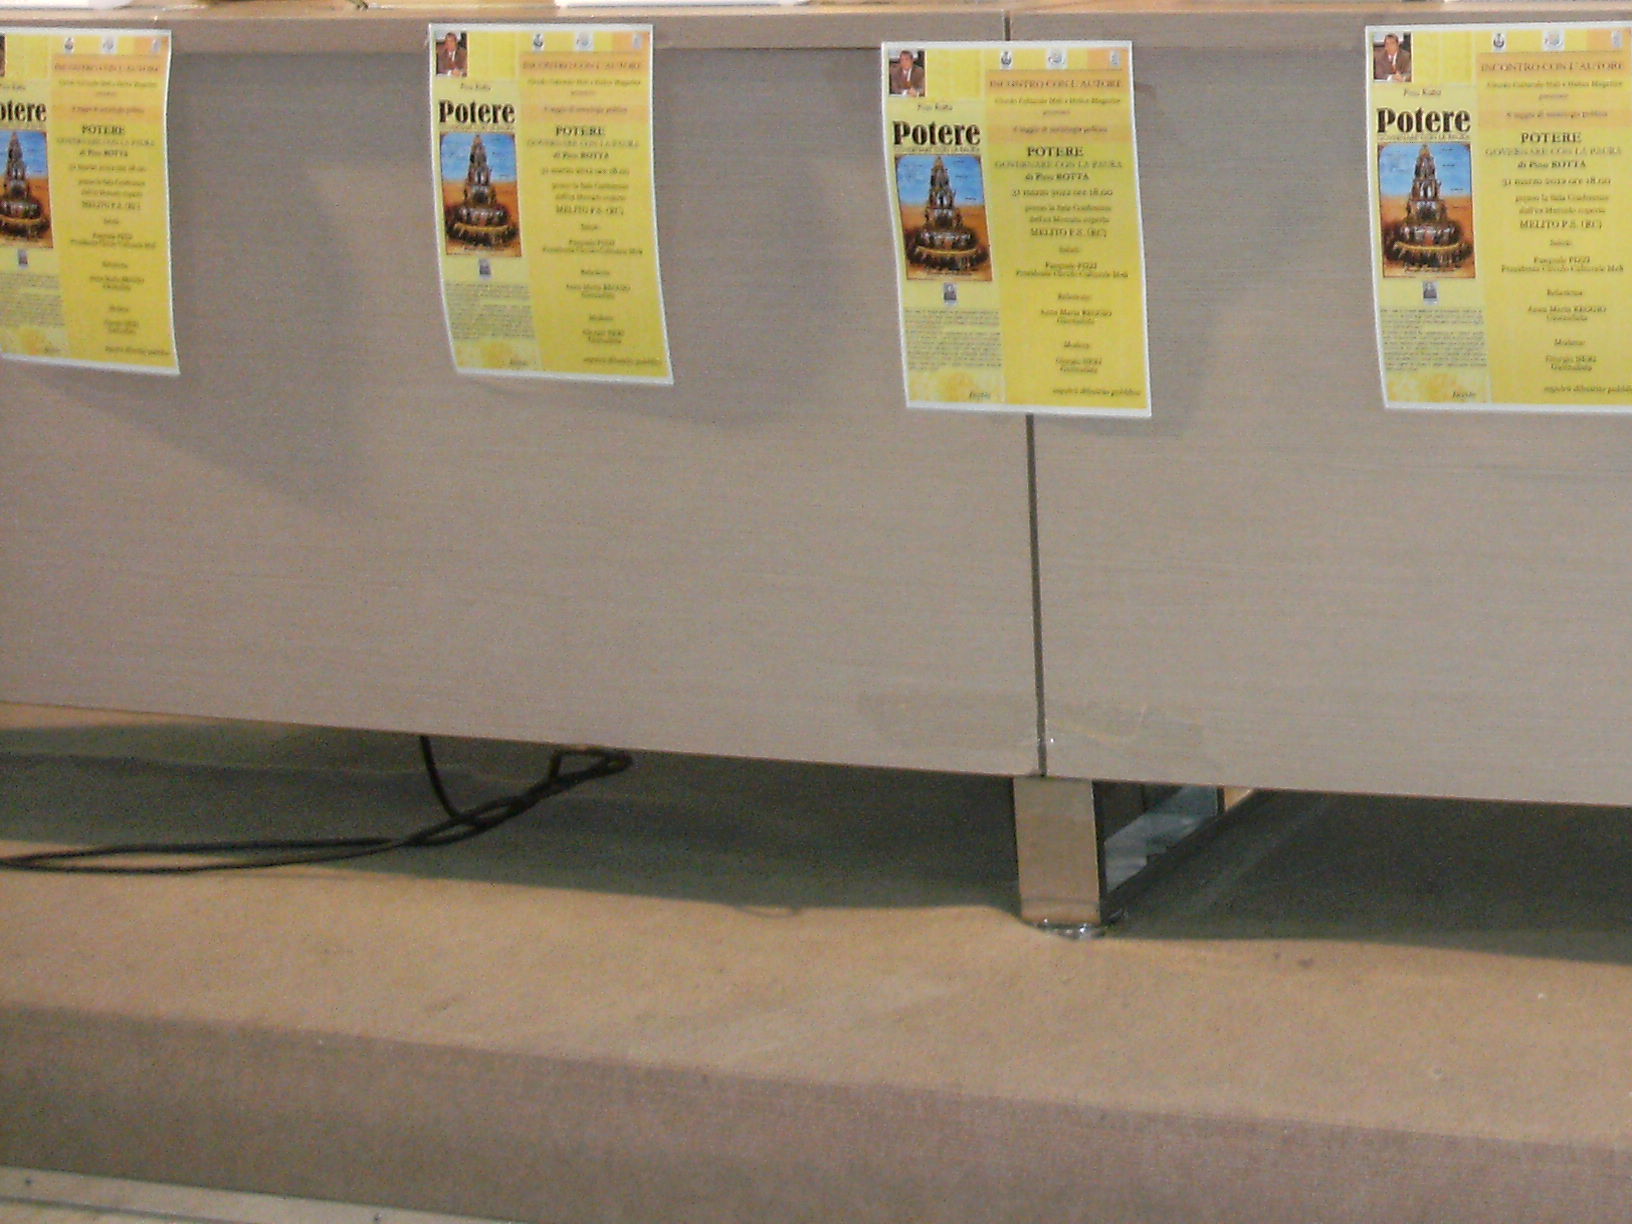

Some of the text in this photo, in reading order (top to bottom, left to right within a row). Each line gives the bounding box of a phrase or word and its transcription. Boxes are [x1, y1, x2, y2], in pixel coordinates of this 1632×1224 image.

[439, 100, 515, 124] Potere
[1377, 107, 1471, 133] Potere
[893, 121, 981, 145] Potere
[1521, 132, 1582, 143] POTERE
[1027, 147, 1084, 157] POTERE
